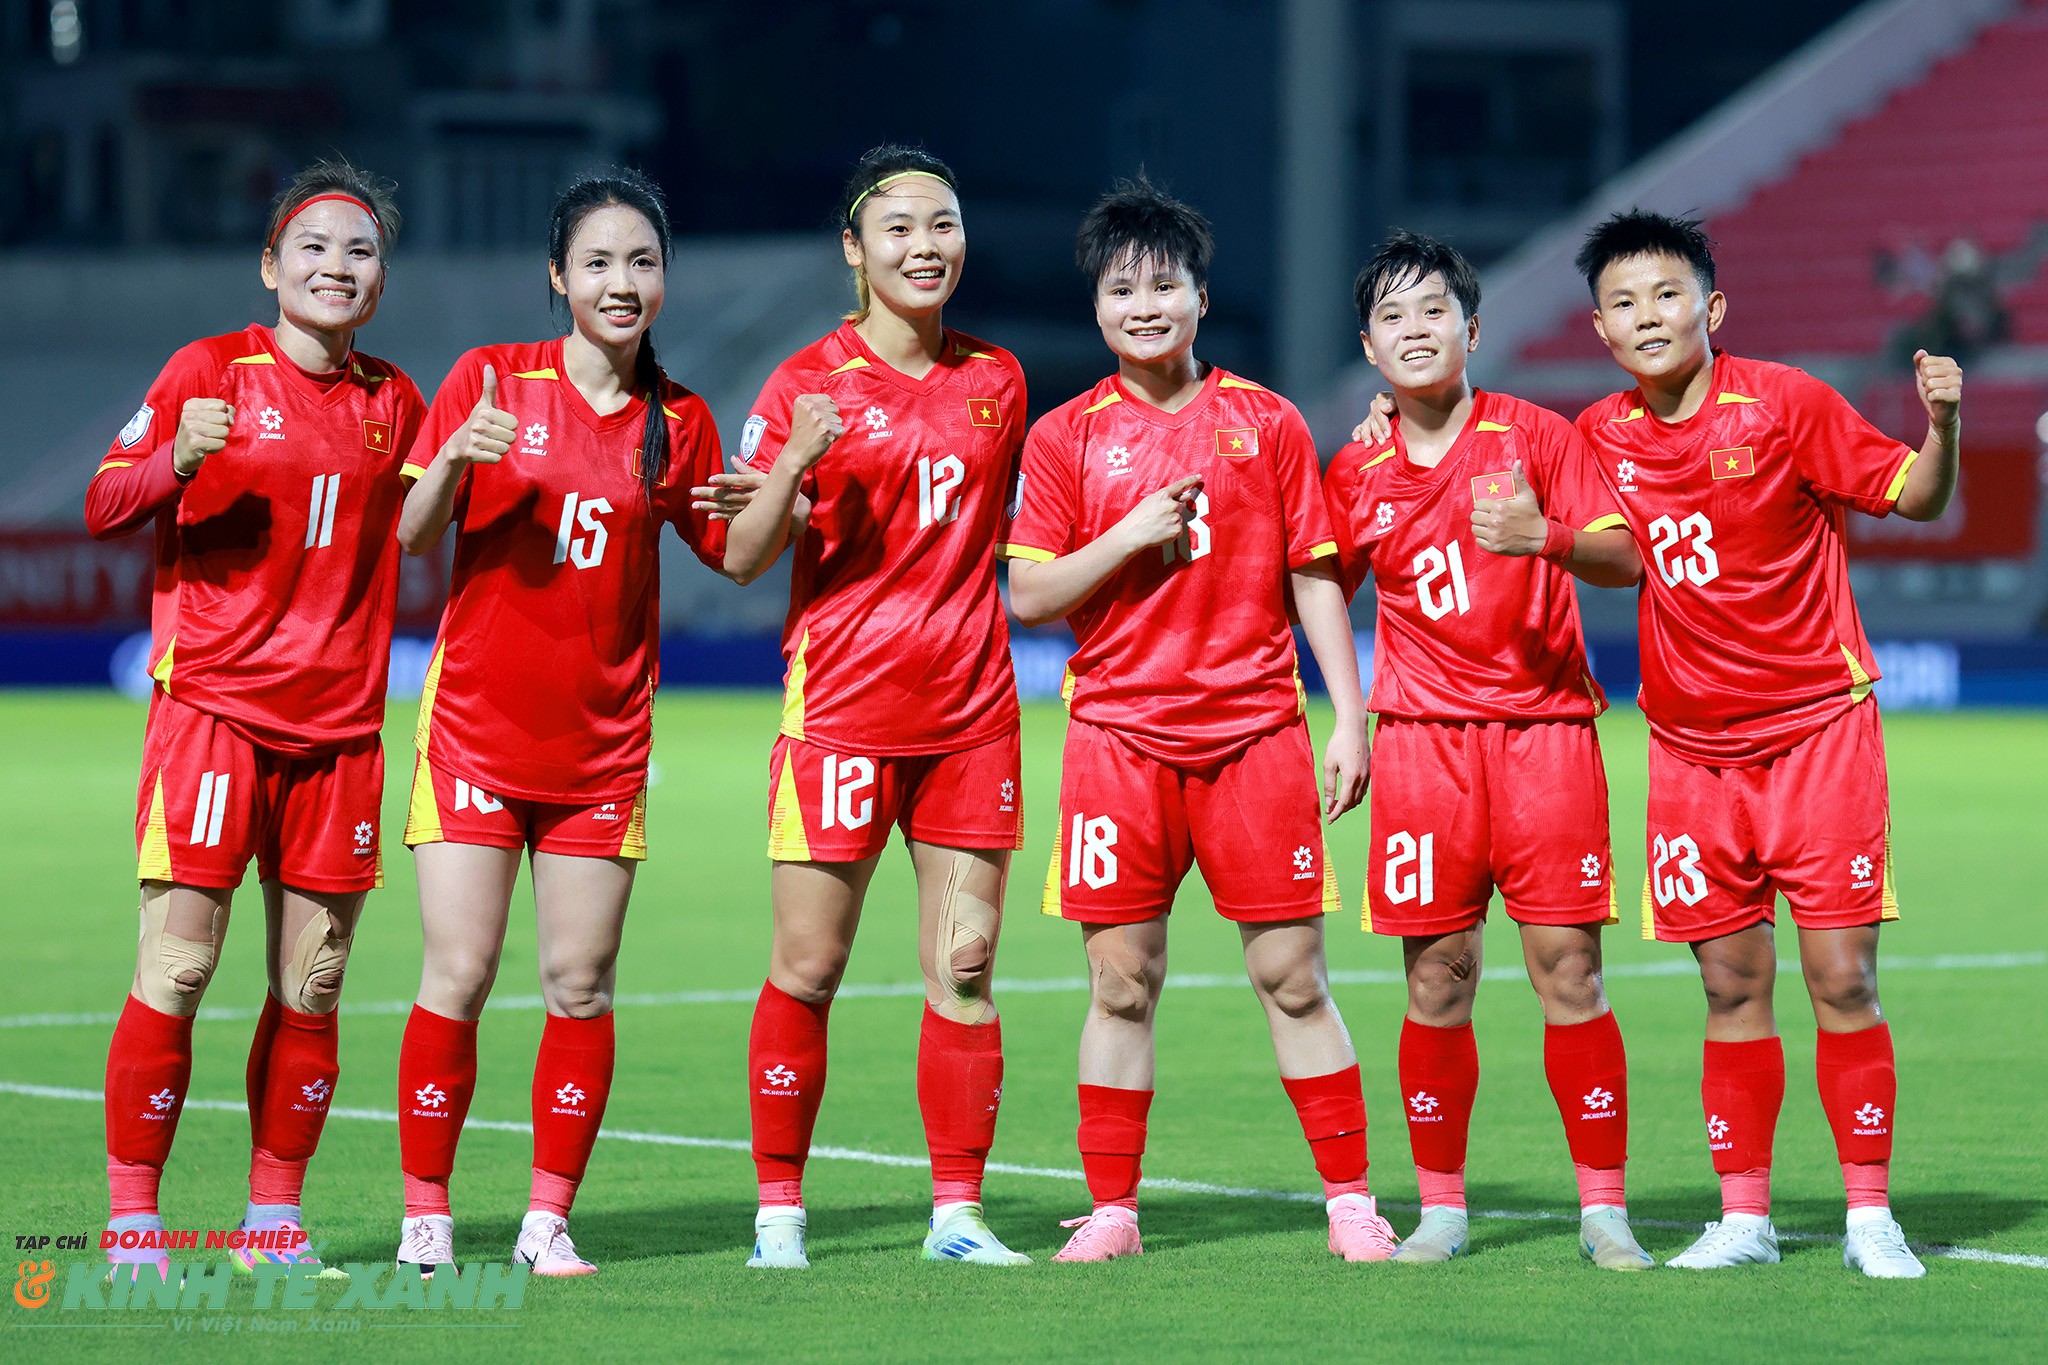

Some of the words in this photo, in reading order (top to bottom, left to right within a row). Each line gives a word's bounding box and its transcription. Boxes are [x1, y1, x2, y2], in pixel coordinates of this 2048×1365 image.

[305, 473, 341, 549] 11
[552, 491, 614, 570] 15
[918, 454, 965, 531] 12
[1412, 539, 1470, 622] 21
[1648, 511, 1720, 589] 23
[190, 770, 230, 848] 11
[821, 753, 875, 831] 12
[1068, 812, 1118, 890] 18
[1384, 830, 1434, 907] 21
[1653, 832, 1709, 908] 23
